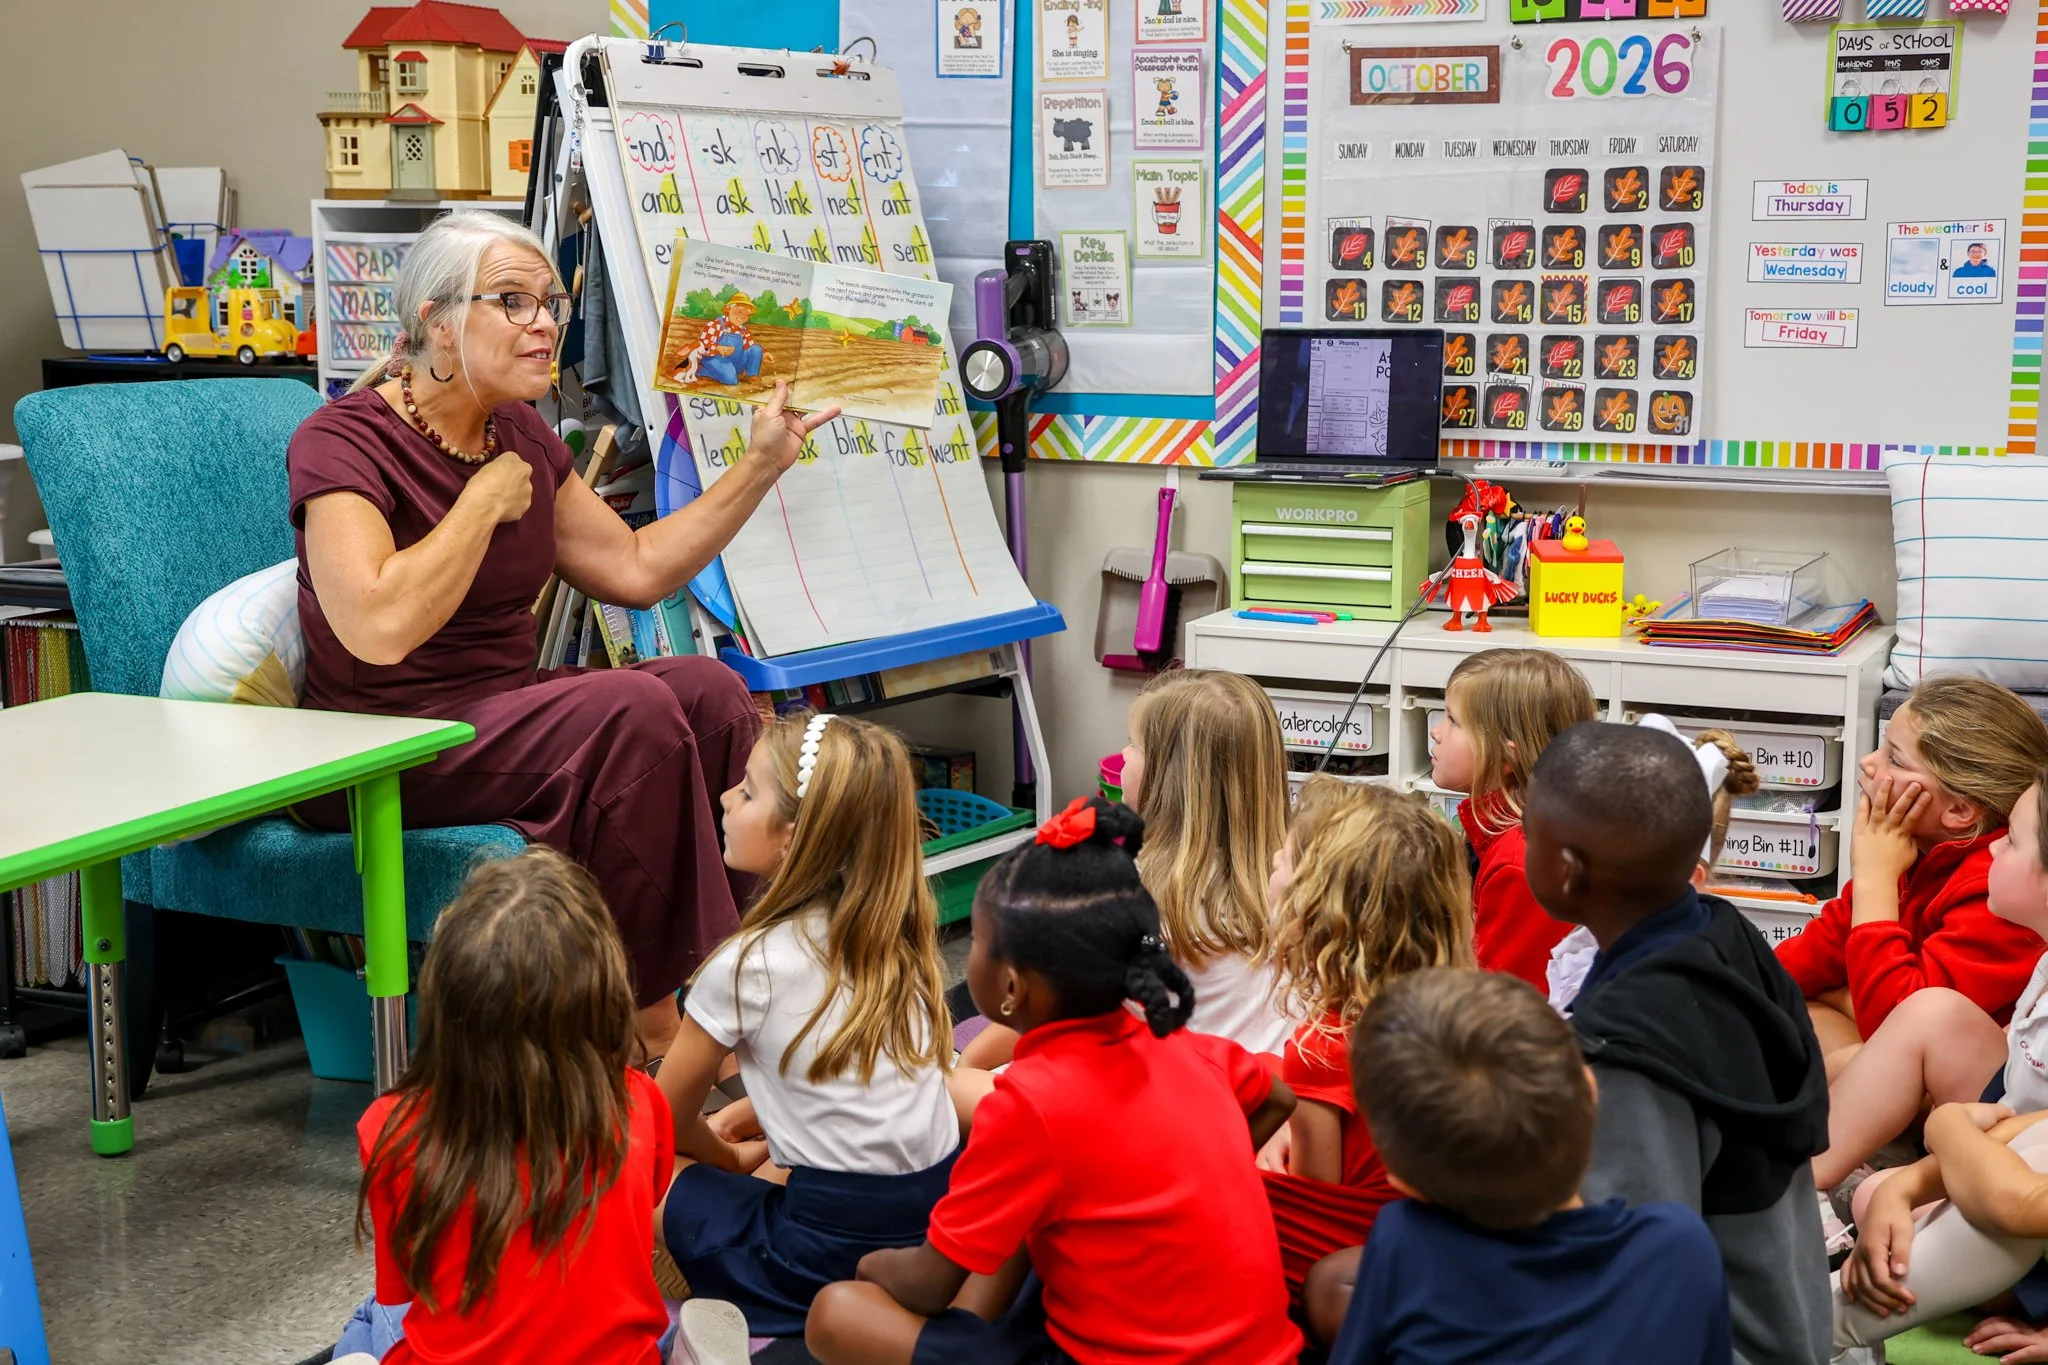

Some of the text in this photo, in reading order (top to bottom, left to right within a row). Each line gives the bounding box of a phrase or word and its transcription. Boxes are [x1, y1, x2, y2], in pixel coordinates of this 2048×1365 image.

[1893, 33, 1952, 50] SCHOOL
[1052, 49, 1064, 57] She
[1135, 54, 1199, 64] Apostrophe with
[1547, 33, 1691, 97] 2026
[1368, 63, 1480, 92] OCTOBER
[1044, 97, 1101, 112] Repetition
[1844, 98, 1938, 125] 0 5 2
[630, 125, 669, 162] -nd
[702, 128, 736, 165] -sk
[760, 129, 792, 166] -nk
[816, 135, 838, 168] -st
[866, 136, 892, 170] -nt
[1338, 143, 1368, 159] SUNDAY
[1395, 142, 1425, 158] MONDAY
[1444, 141, 1477, 157] TUESDAY
[1492, 139, 1537, 157] WEDNESDAY
[1549, 139, 1590, 156] THURSDAY
[1608, 137, 1637, 154] FRIDAY
[1659, 135, 1698, 153] SATURDAY
[1136, 168, 1198, 184] Main Topic
[641, 173, 684, 214] and
[716, 179, 754, 214] ask
[765, 179, 812, 216] blink
[827, 178, 863, 215] nest
[882, 181, 911, 214] ant
[1783, 182, 1838, 195] Today is
[1579, 193, 1586, 210] 1
[1637, 190, 1647, 209] 2
[1692, 190, 1702, 209] 3
[1775, 199, 1845, 215] Thursday
[1898, 222, 1994, 235] The weather is
[837, 225, 878, 265] must
[893, 225, 930, 263] sent
[1080, 236, 1106, 251] Key
[1754, 245, 1857, 260] Yesterday was
[356, 251, 395, 276] PAP
[1074, 249, 1115, 262] Details
[1363, 252, 1372, 268] 4
[1416, 250, 1425, 269] 5
[1466, 250, 1475, 267] 6
[1525, 248, 1534, 267] 7
[1573, 249, 1584, 268] 8
[1631, 248, 1641, 267] 9
[1678, 246, 1694, 266] 10
[1940, 259, 1949, 271] &
[1766, 263, 1845, 279] Wednesday
[1890, 281, 1934, 297] cloudy
[1956, 283, 1988, 295] cool
[1354, 301, 1365, 318] 11
[1406, 303, 1422, 321] 12
[1463, 303, 1479, 321] 13
[1517, 303, 1532, 322] 14
[1567, 303, 1584, 323] 15
[1624, 302, 1640, 321] 16
[1679, 302, 1694, 321] 17
[1749, 310, 1855, 321] Tomorrow will be
[335, 332, 398, 351] COLORIN
[1779, 325, 1828, 341] Friday
[1455, 356, 1473, 375] 20
[1512, 356, 1527, 375] 21
[1564, 359, 1582, 377] 22
[1618, 358, 1636, 376] 23
[1678, 358, 1694, 377] 24
[1459, 407, 1476, 426] 27
[1506, 410, 1525, 429] 28
[1564, 410, 1582, 430] 29
[1615, 411, 1635, 431] 30
[1674, 416, 1691, 433] 31
[831, 417, 878, 457] blink
[930, 424, 971, 464] went
[885, 427, 924, 467] fast
[1276, 507, 1358, 523] WORKPRO
[1451, 568, 1484, 578] CHEER
[1545, 591, 1618, 604] LUCKY DUCKS
[1757, 747, 1778, 765] Bin
[1783, 750, 1813, 768] #10
[1752, 834, 1805, 857] Bin #11
